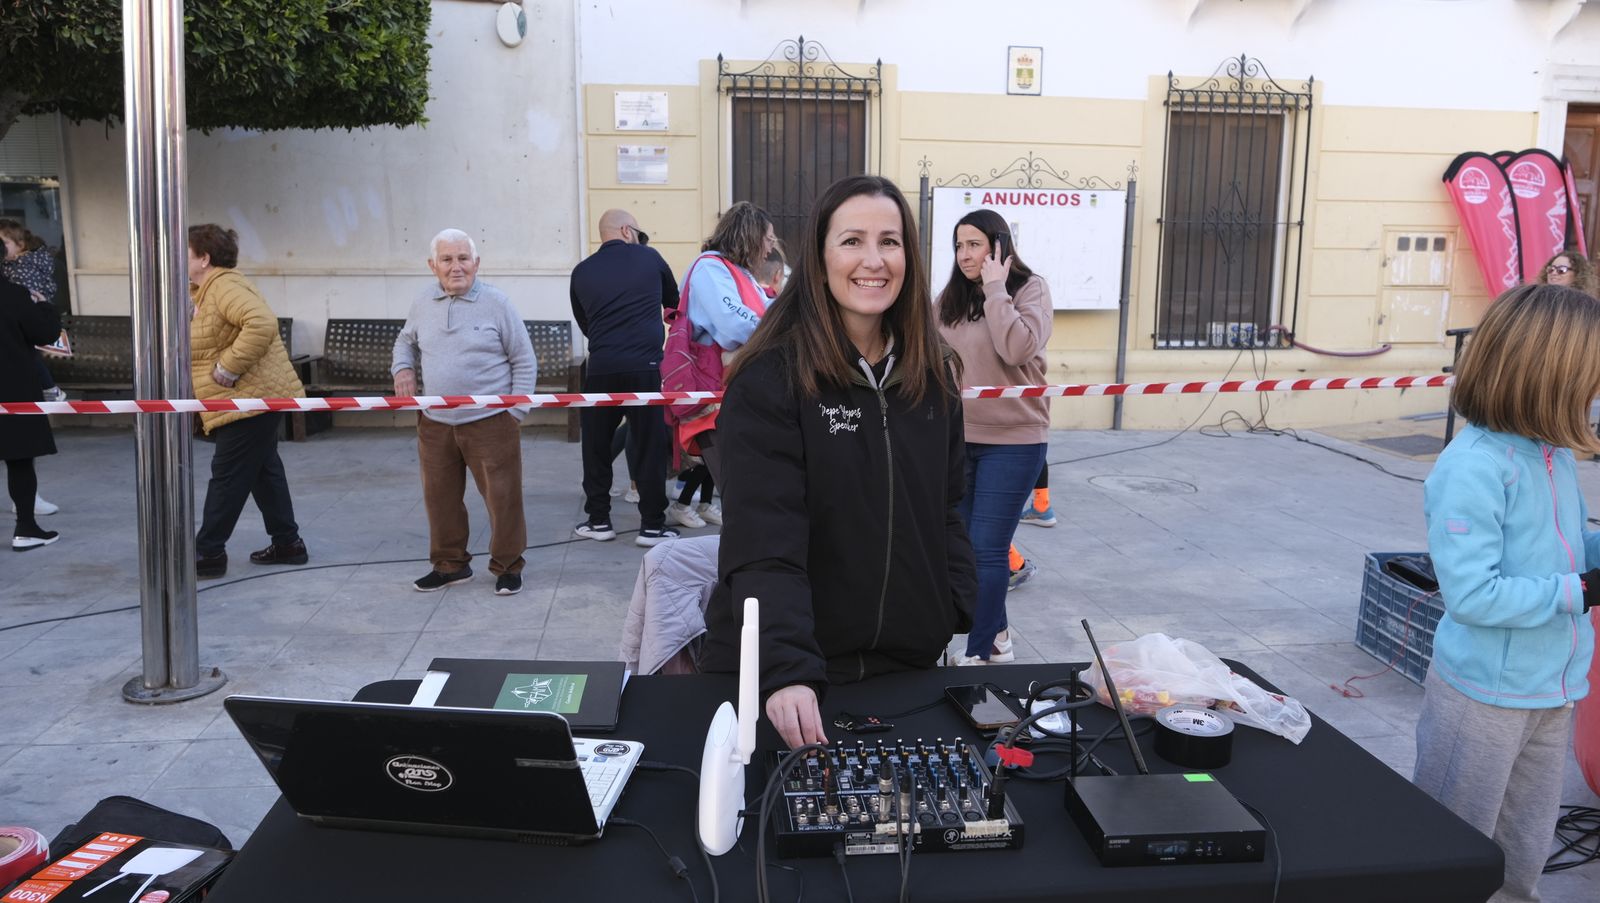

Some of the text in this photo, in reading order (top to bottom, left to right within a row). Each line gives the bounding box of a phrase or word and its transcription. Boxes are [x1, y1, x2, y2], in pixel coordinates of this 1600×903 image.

[981, 191, 1081, 207] ANUNCIOS
[828, 418, 859, 435] Speaker
[1192, 718, 1205, 727] 3M
[9, 889, 52, 903] N300
